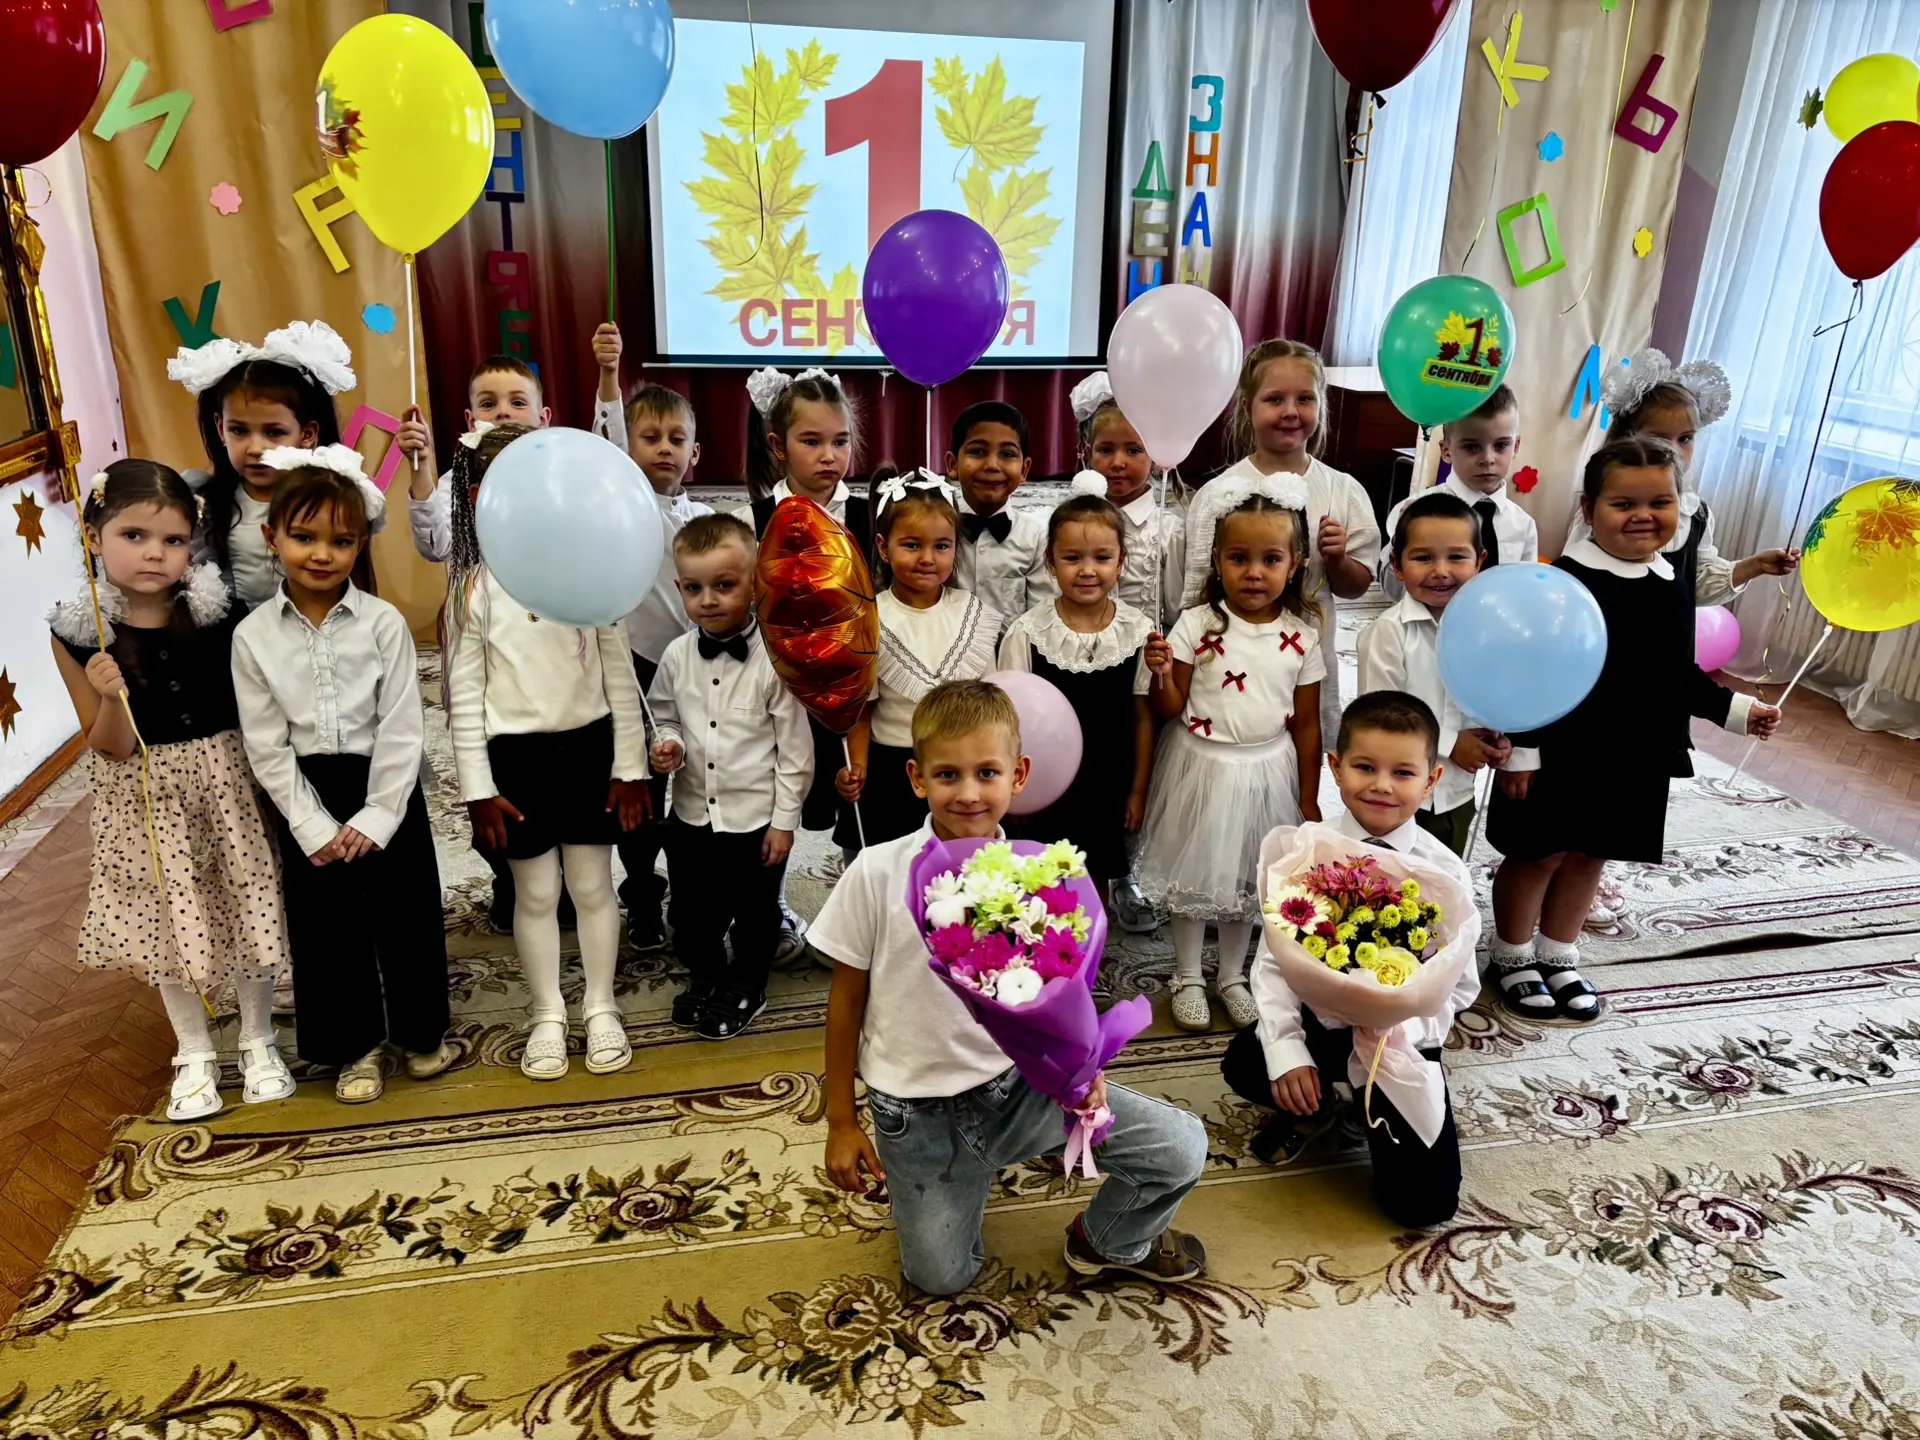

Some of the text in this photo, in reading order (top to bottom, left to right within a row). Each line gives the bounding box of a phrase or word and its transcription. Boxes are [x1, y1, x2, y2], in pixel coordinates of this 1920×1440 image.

[824, 58, 923, 255] 1
[1127, 140, 1175, 305] ДЕН
[739, 298, 1036, 347] СЕНЯ
[1459, 317, 1483, 367] 1
